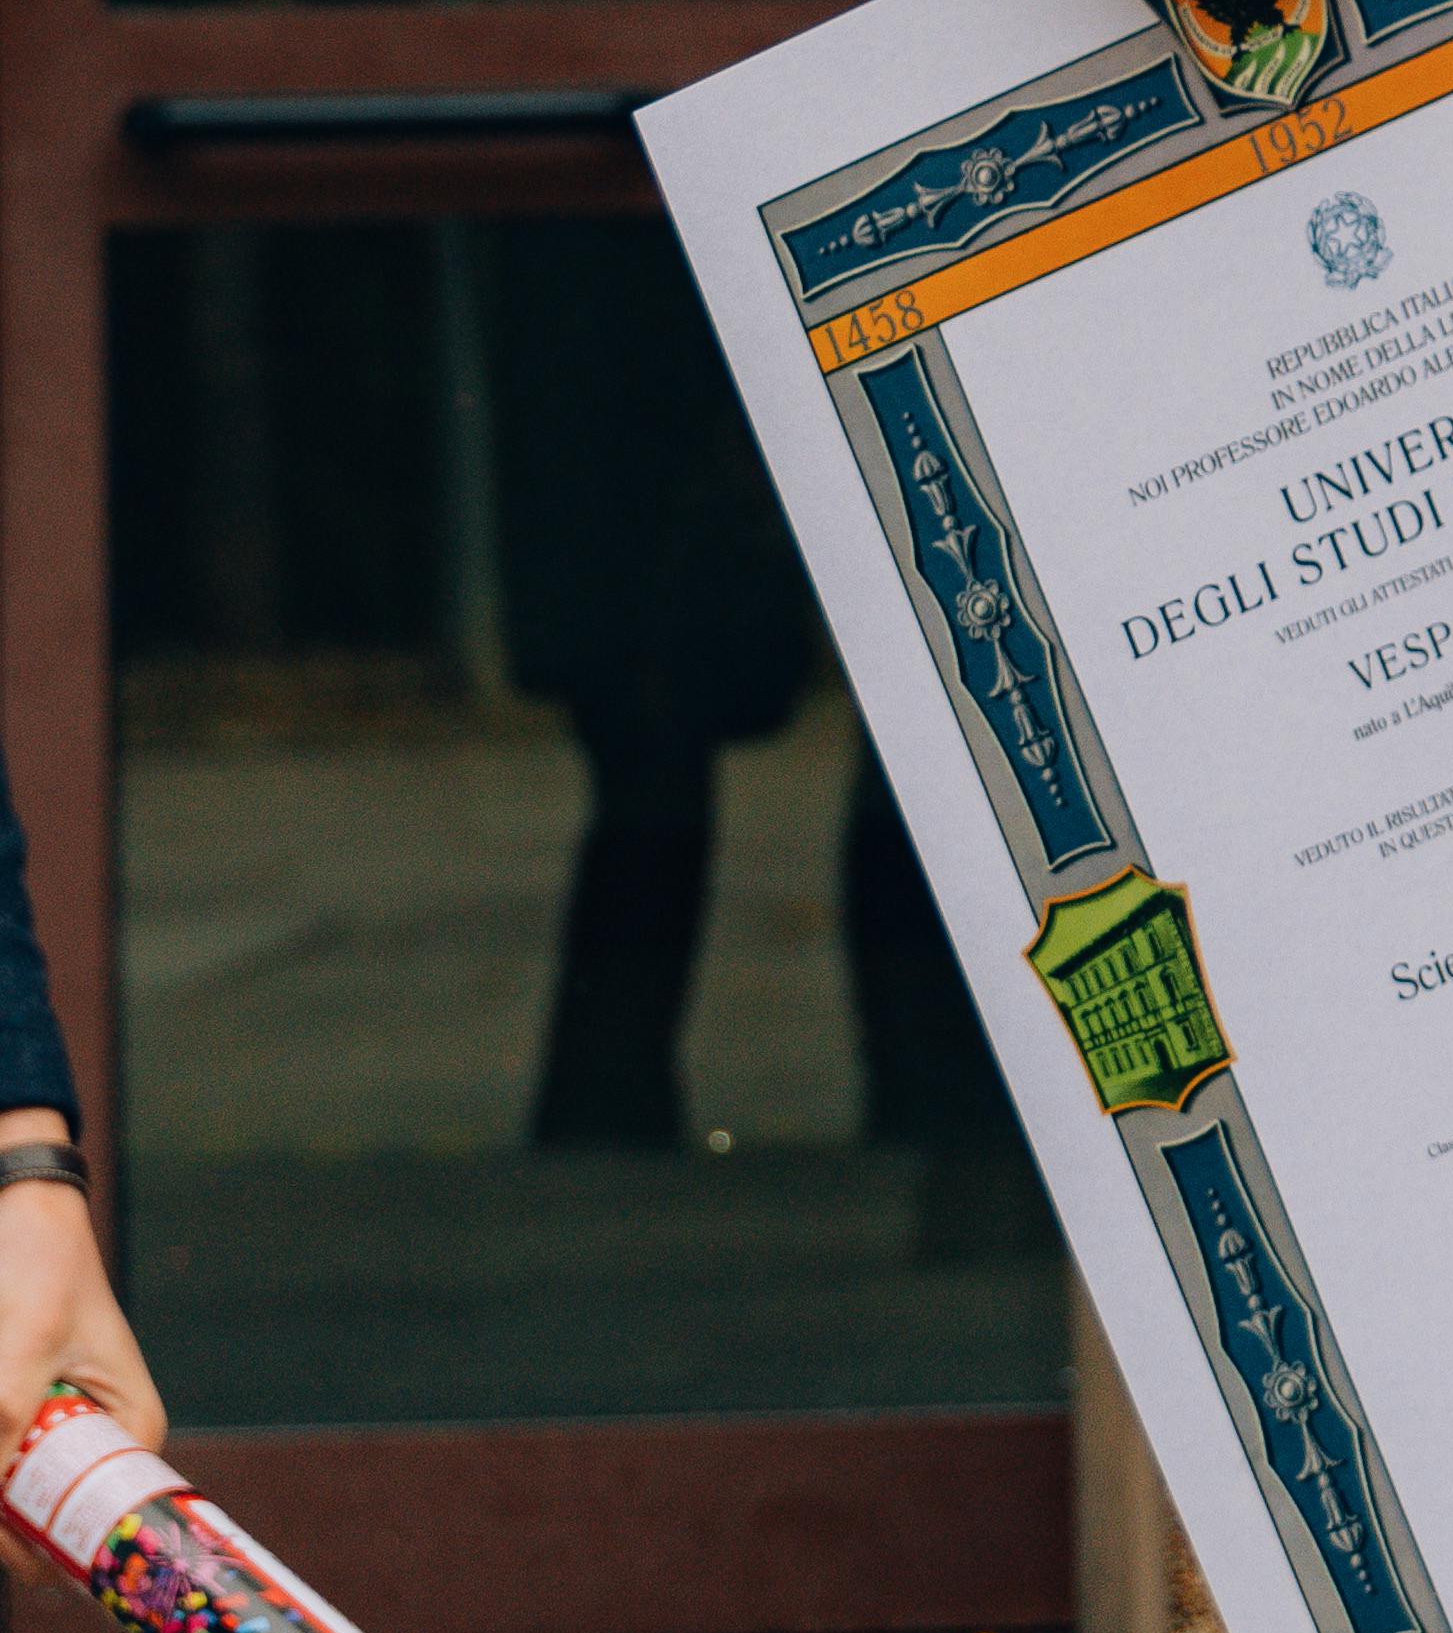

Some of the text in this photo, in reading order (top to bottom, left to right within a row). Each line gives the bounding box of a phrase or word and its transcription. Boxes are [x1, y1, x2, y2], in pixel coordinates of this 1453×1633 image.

[1246, 92, 1357, 177] 1952
[822, 285, 927, 365] 1458
[1265, 307, 1399, 381] REPUBBLICA
[1270, 384, 1296, 411] IN
[1295, 357, 1363, 399] NOME
[1363, 324, 1436, 370] DELLA
[1127, 473, 1169, 507] NOI
[1170, 411, 1311, 488] PROFESSORE
[1311, 365, 1417, 426] EDOARDO
[1120, 560, 1278, 660] DEGLI
[1291, 489, 1443, 585] STUDI
[1273, 605, 1338, 644] VEDUTI
[1337, 592, 1368, 617] GLI
[1370, 555, 1453, 605] ATTESTATI
[1352, 716, 1388, 741] nato
[1390, 710, 1402, 726] a
[1292, 827, 1364, 867] VEDUTO
[1364, 820, 1385, 839] IL
[1377, 838, 1398, 859] IN
